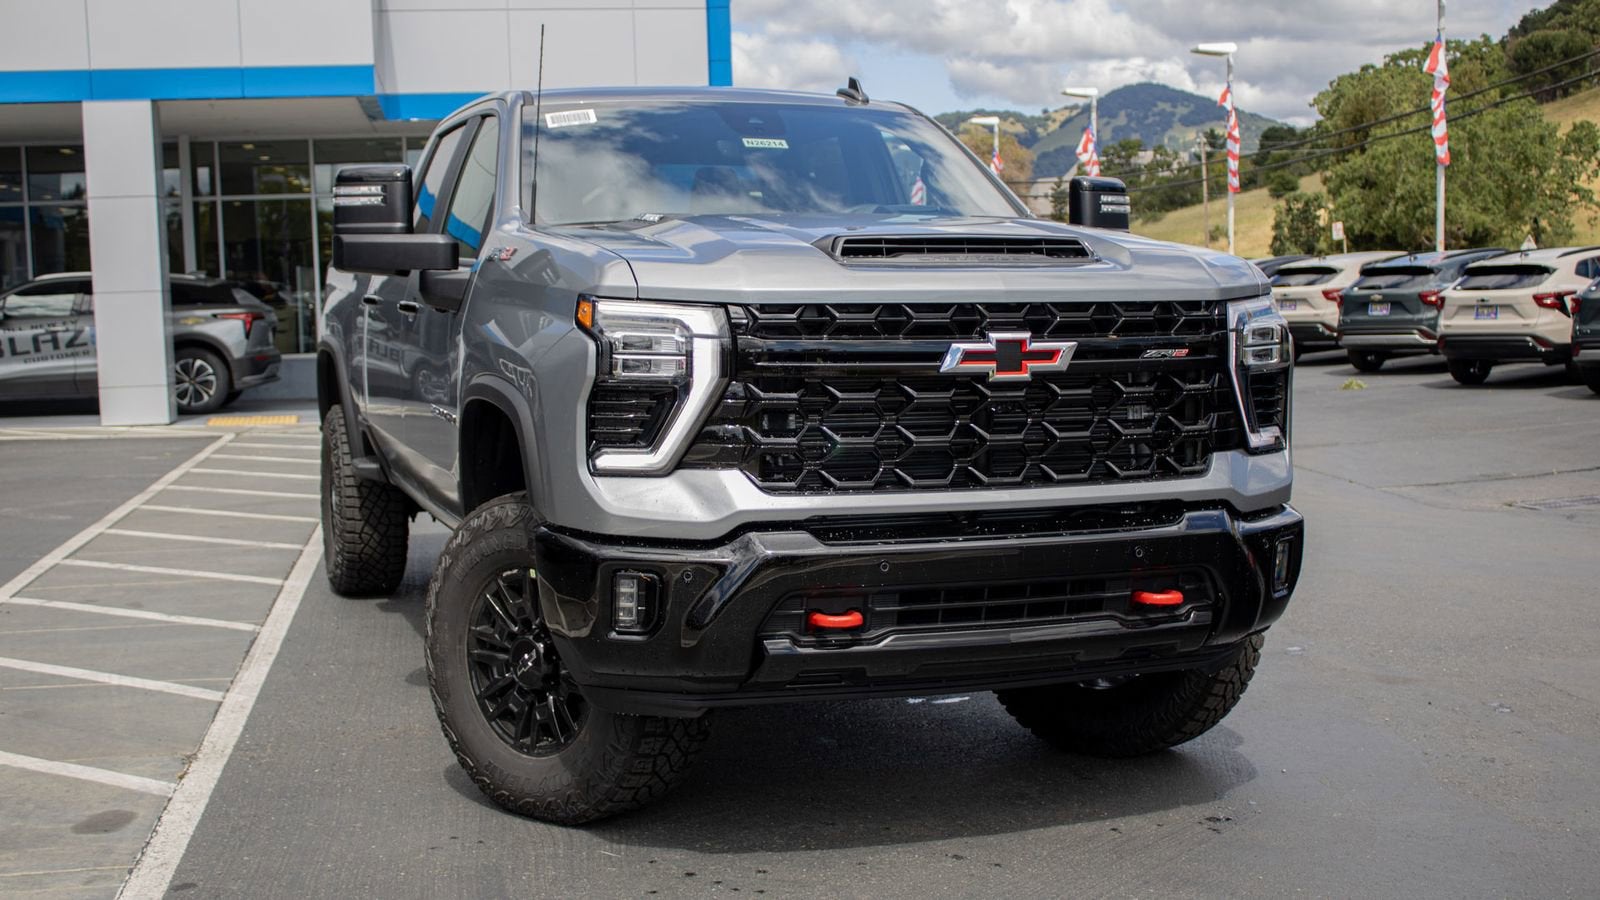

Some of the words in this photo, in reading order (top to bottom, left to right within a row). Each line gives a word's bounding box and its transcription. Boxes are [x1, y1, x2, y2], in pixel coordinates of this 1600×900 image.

[745, 139, 786, 147] N26214
[0, 327, 97, 358] LAZ
[23, 349, 91, 363] CUSTOMER
[1143, 349, 1189, 357] ZR2
